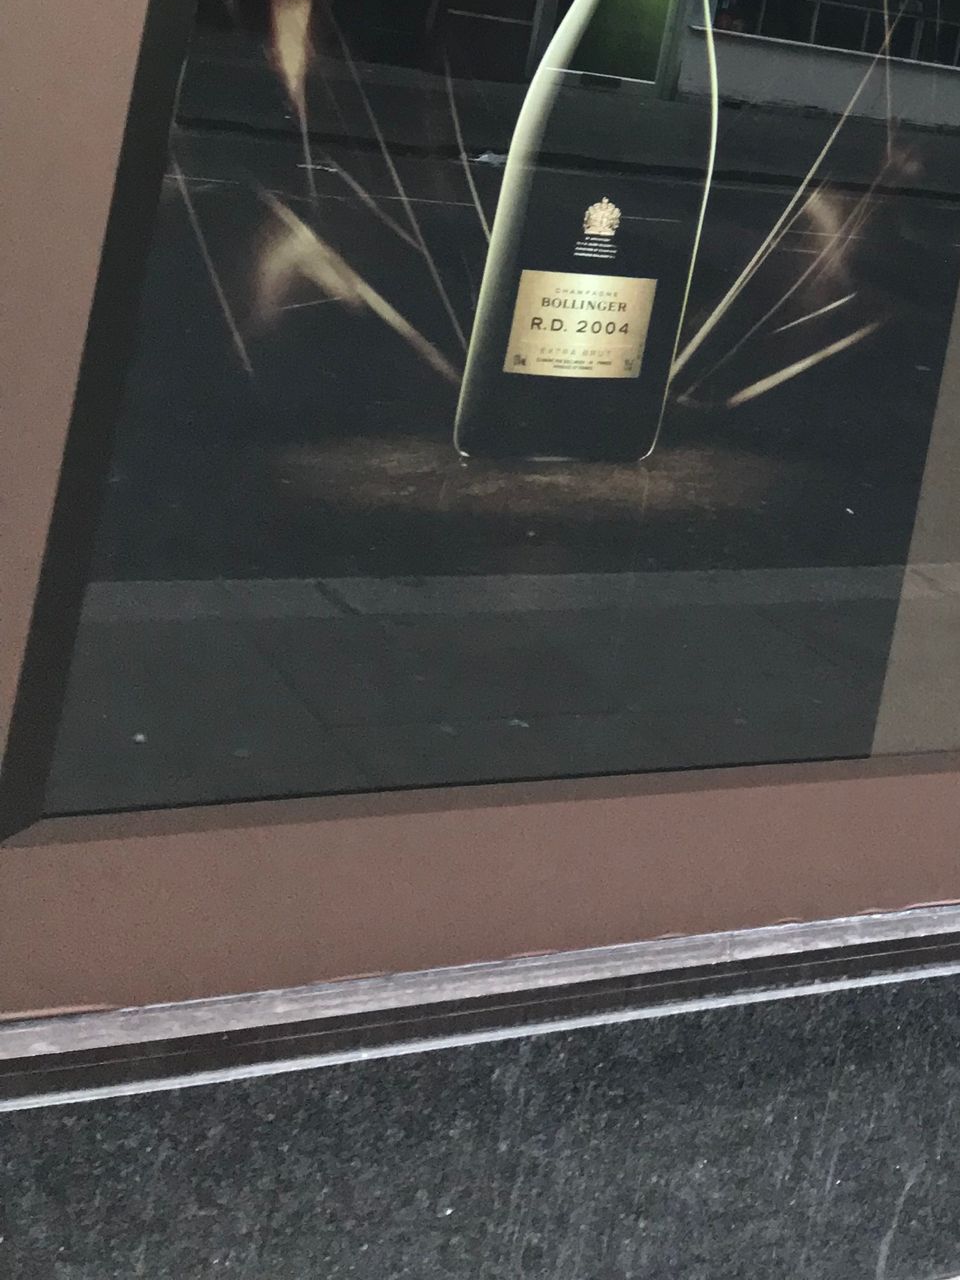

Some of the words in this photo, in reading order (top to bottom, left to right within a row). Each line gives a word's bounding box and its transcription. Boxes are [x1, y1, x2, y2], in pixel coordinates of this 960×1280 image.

[555, 287, 619, 298] CHAMPAGNE
[541, 296, 628, 313] BOLLINGER
[530, 316, 568, 332] R.D.
[576, 320, 630, 335] 2004
